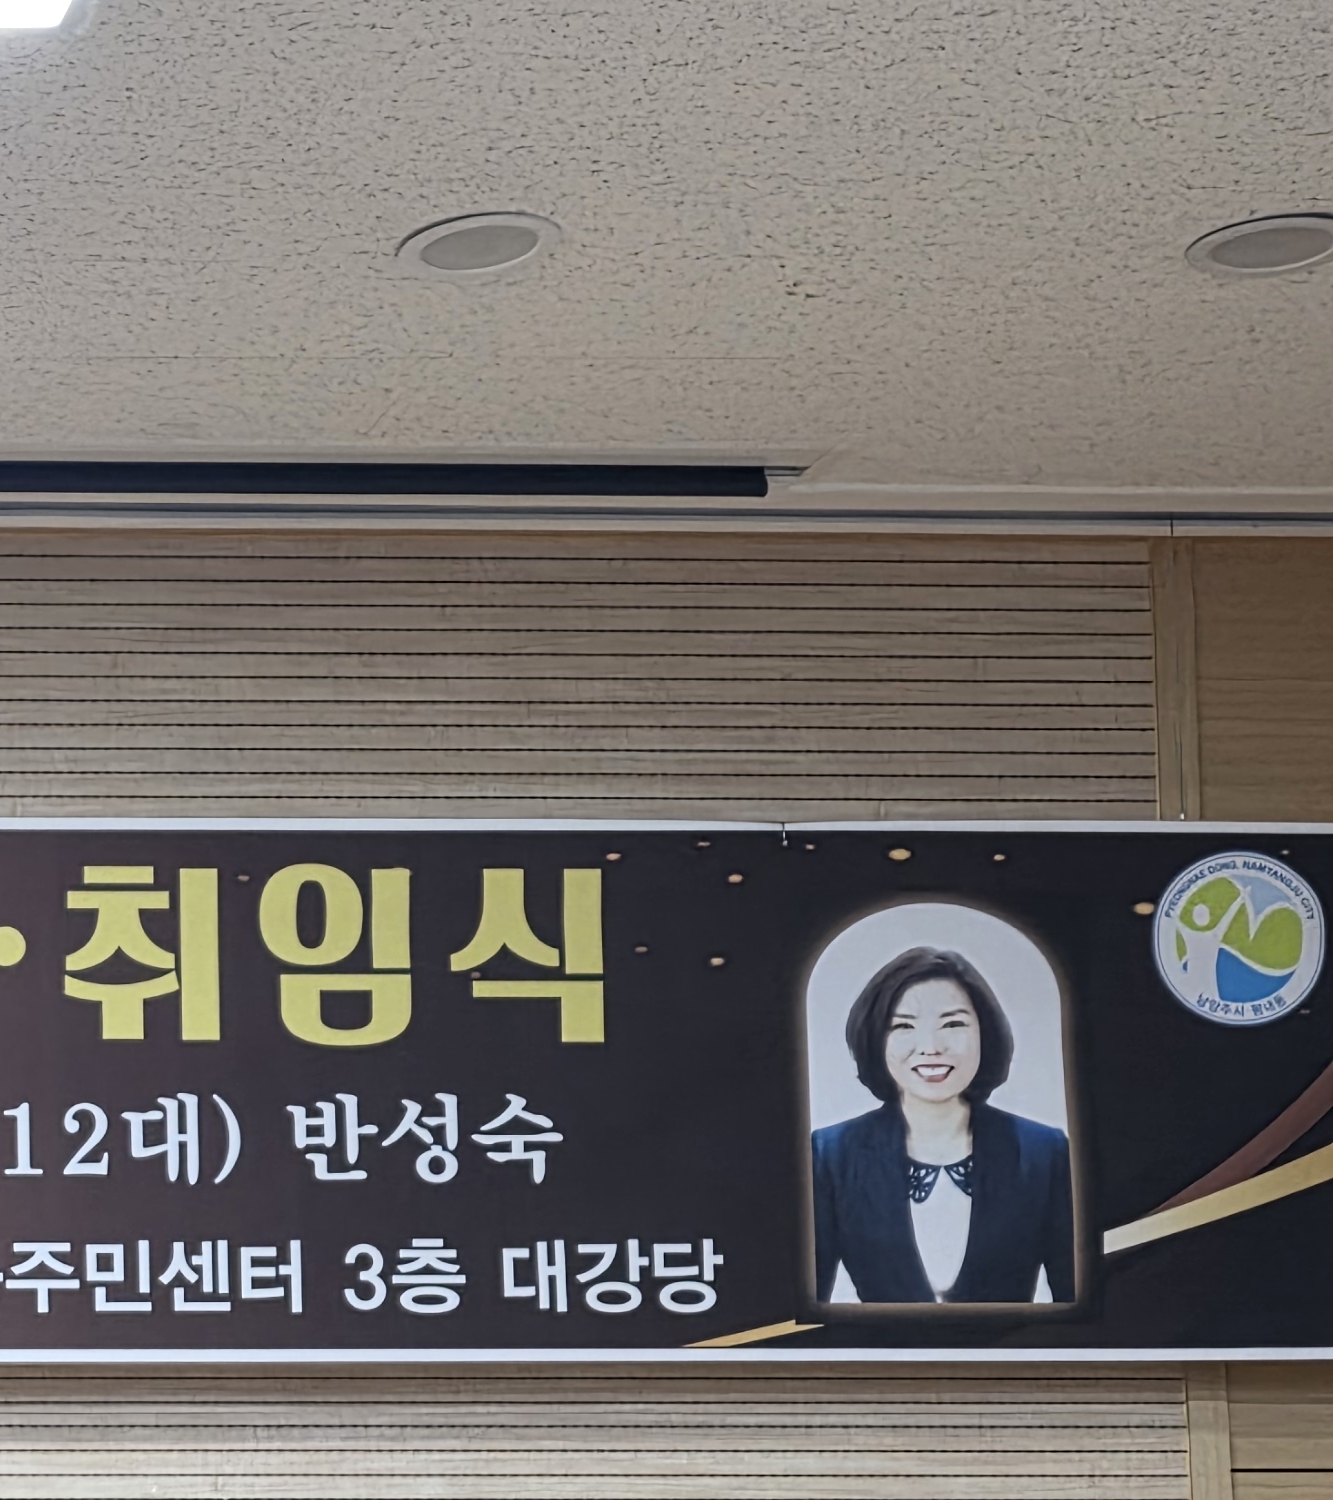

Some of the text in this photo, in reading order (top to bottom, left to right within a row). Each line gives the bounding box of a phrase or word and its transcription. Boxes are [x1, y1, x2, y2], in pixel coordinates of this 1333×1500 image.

[285, 1092, 564, 1185] 반성숙
[343, 1238, 467, 1314] 3층
[502, 1238, 724, 1314] 대강당
